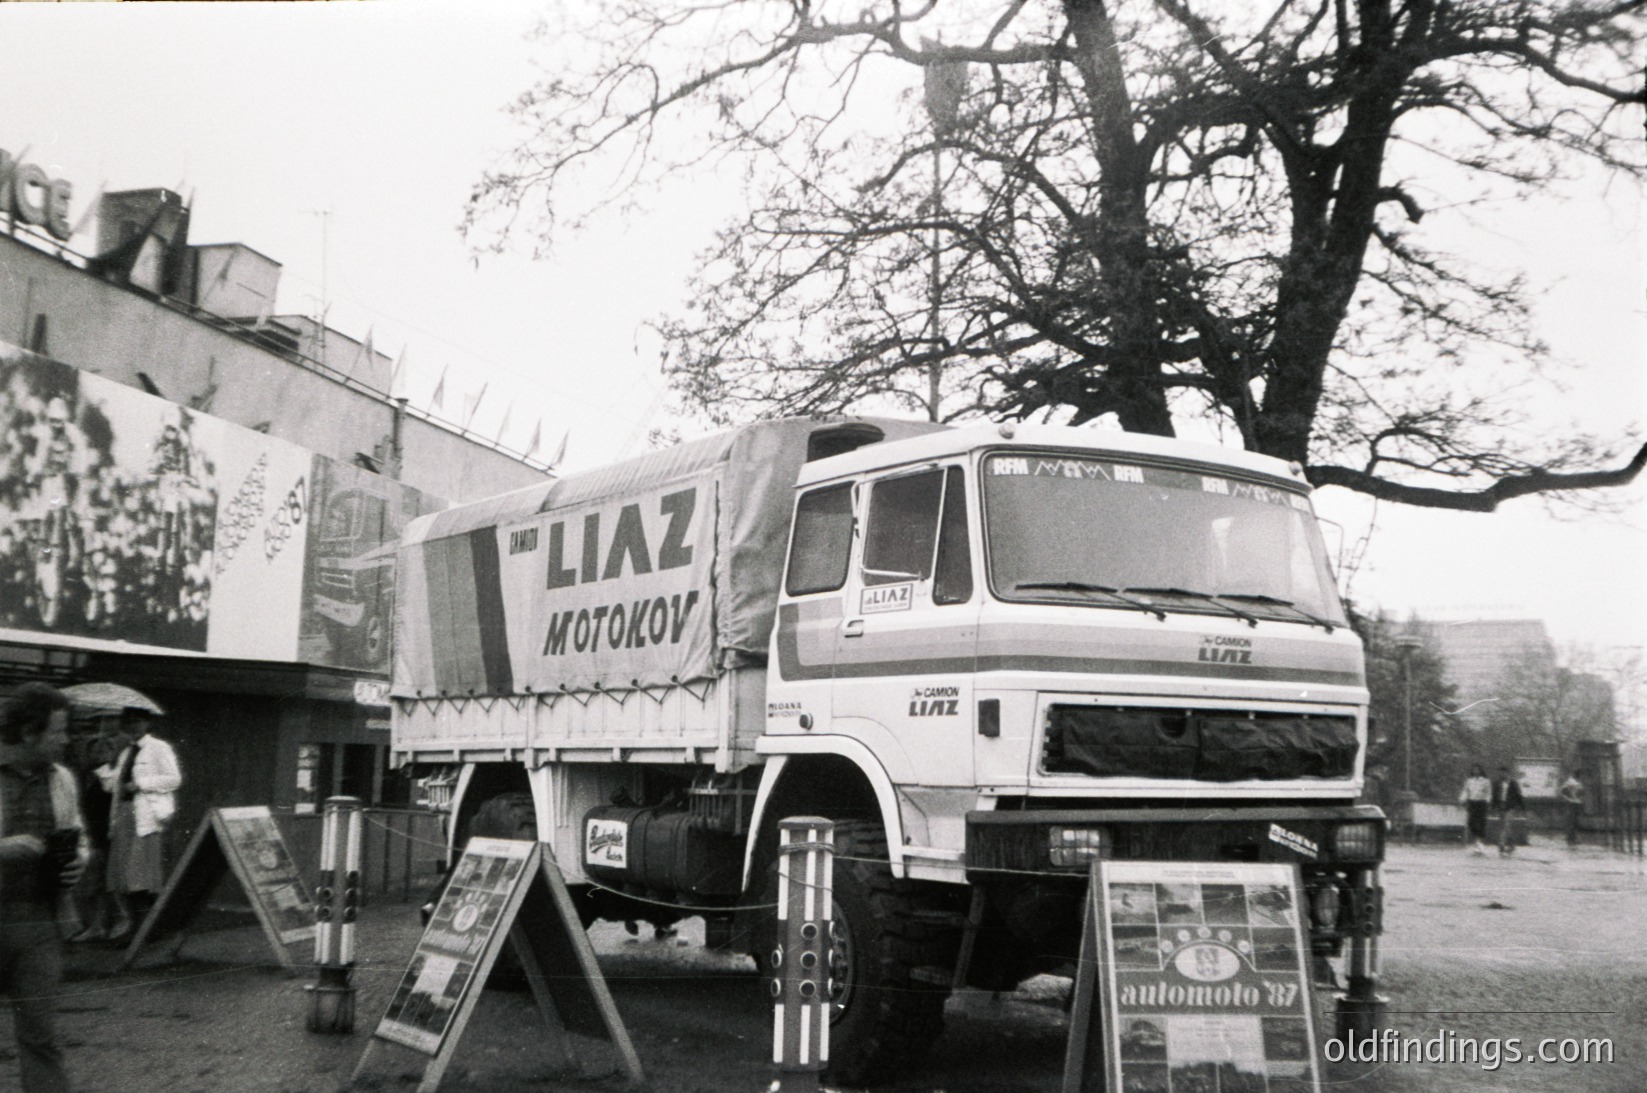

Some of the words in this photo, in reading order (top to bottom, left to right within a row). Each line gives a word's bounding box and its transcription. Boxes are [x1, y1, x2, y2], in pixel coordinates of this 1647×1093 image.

[546, 487, 697, 590] LIAZ
[873, 587, 908, 604] LIAZ
[543, 590, 699, 656] MOTOKOV
[1215, 635, 1252, 647] CAMION
[1198, 647, 1252, 664] LIAZ
[924, 687, 960, 698] CAMION
[908, 699, 960, 717] LIAZ
[1120, 980, 1260, 1007] automoto
